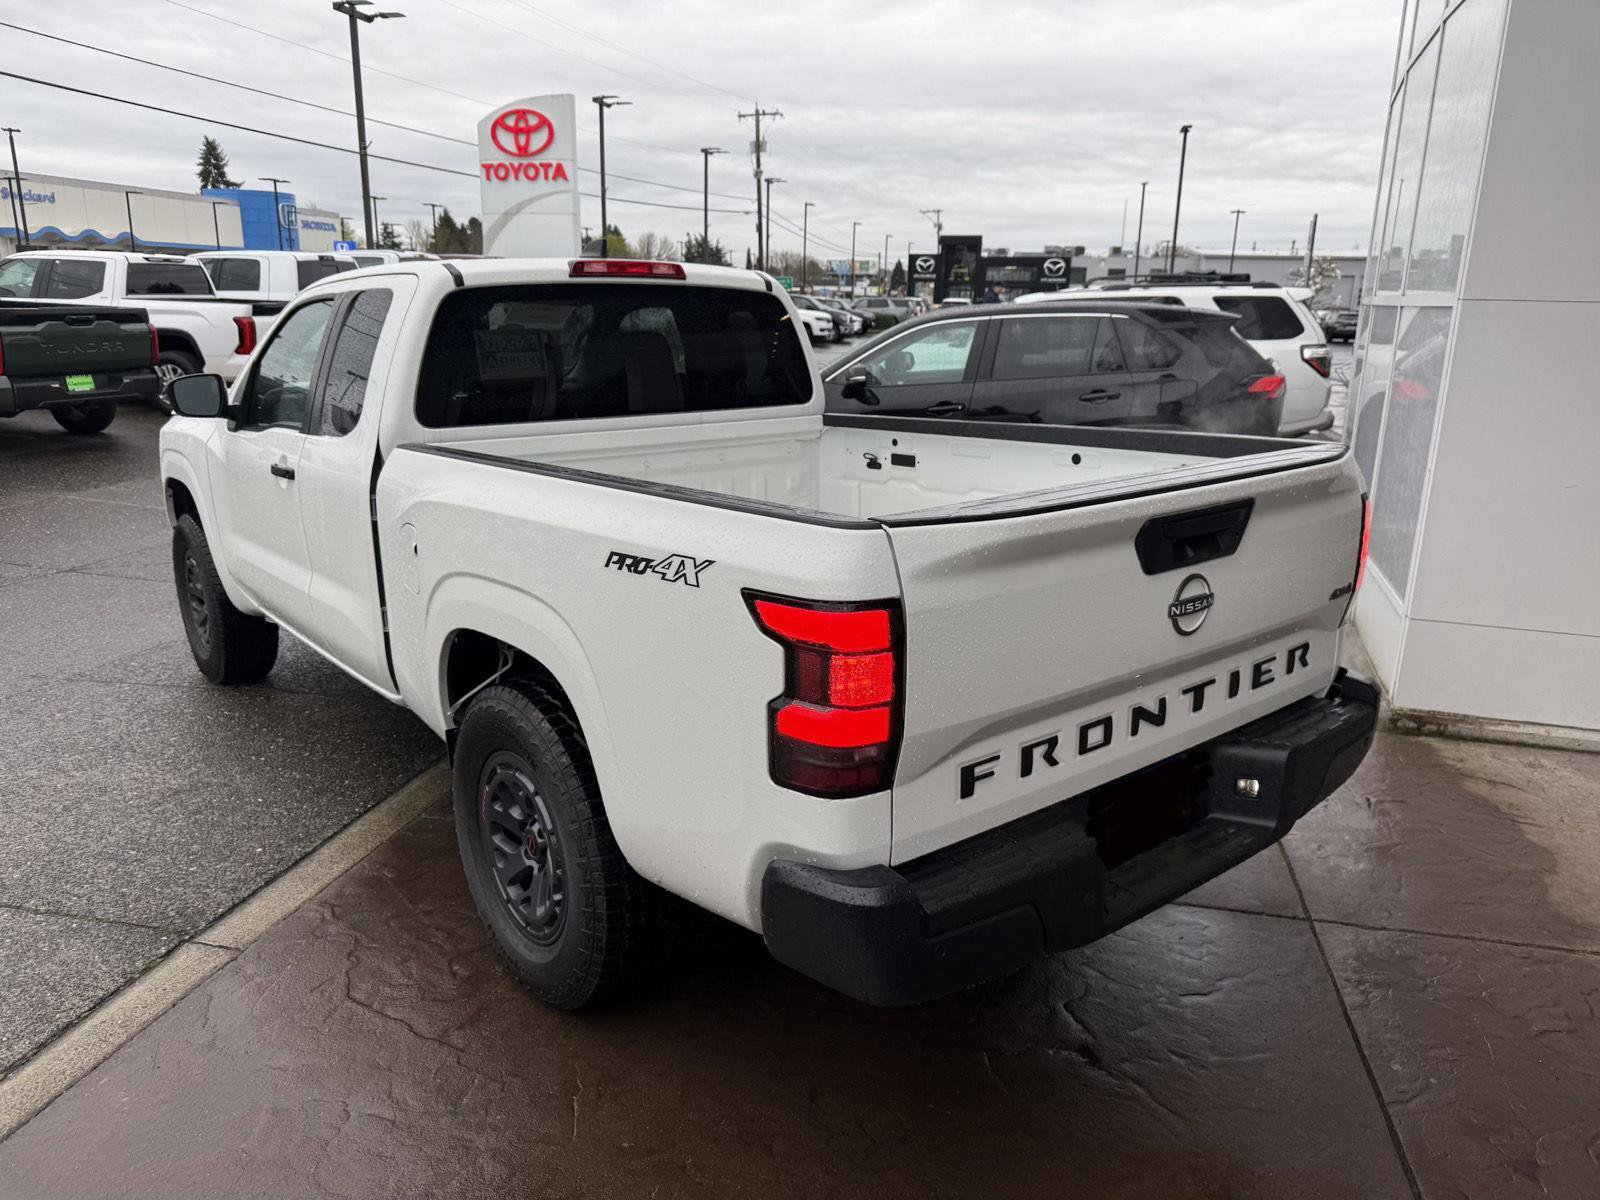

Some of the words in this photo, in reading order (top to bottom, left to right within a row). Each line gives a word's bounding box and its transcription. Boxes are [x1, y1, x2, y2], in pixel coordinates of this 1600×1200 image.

[481, 162, 569, 182] TOYOTA
[604, 551, 716, 588] PRO-4X
[1170, 596, 1214, 616] NISSAN
[959, 641, 1310, 800] FRONTIER
